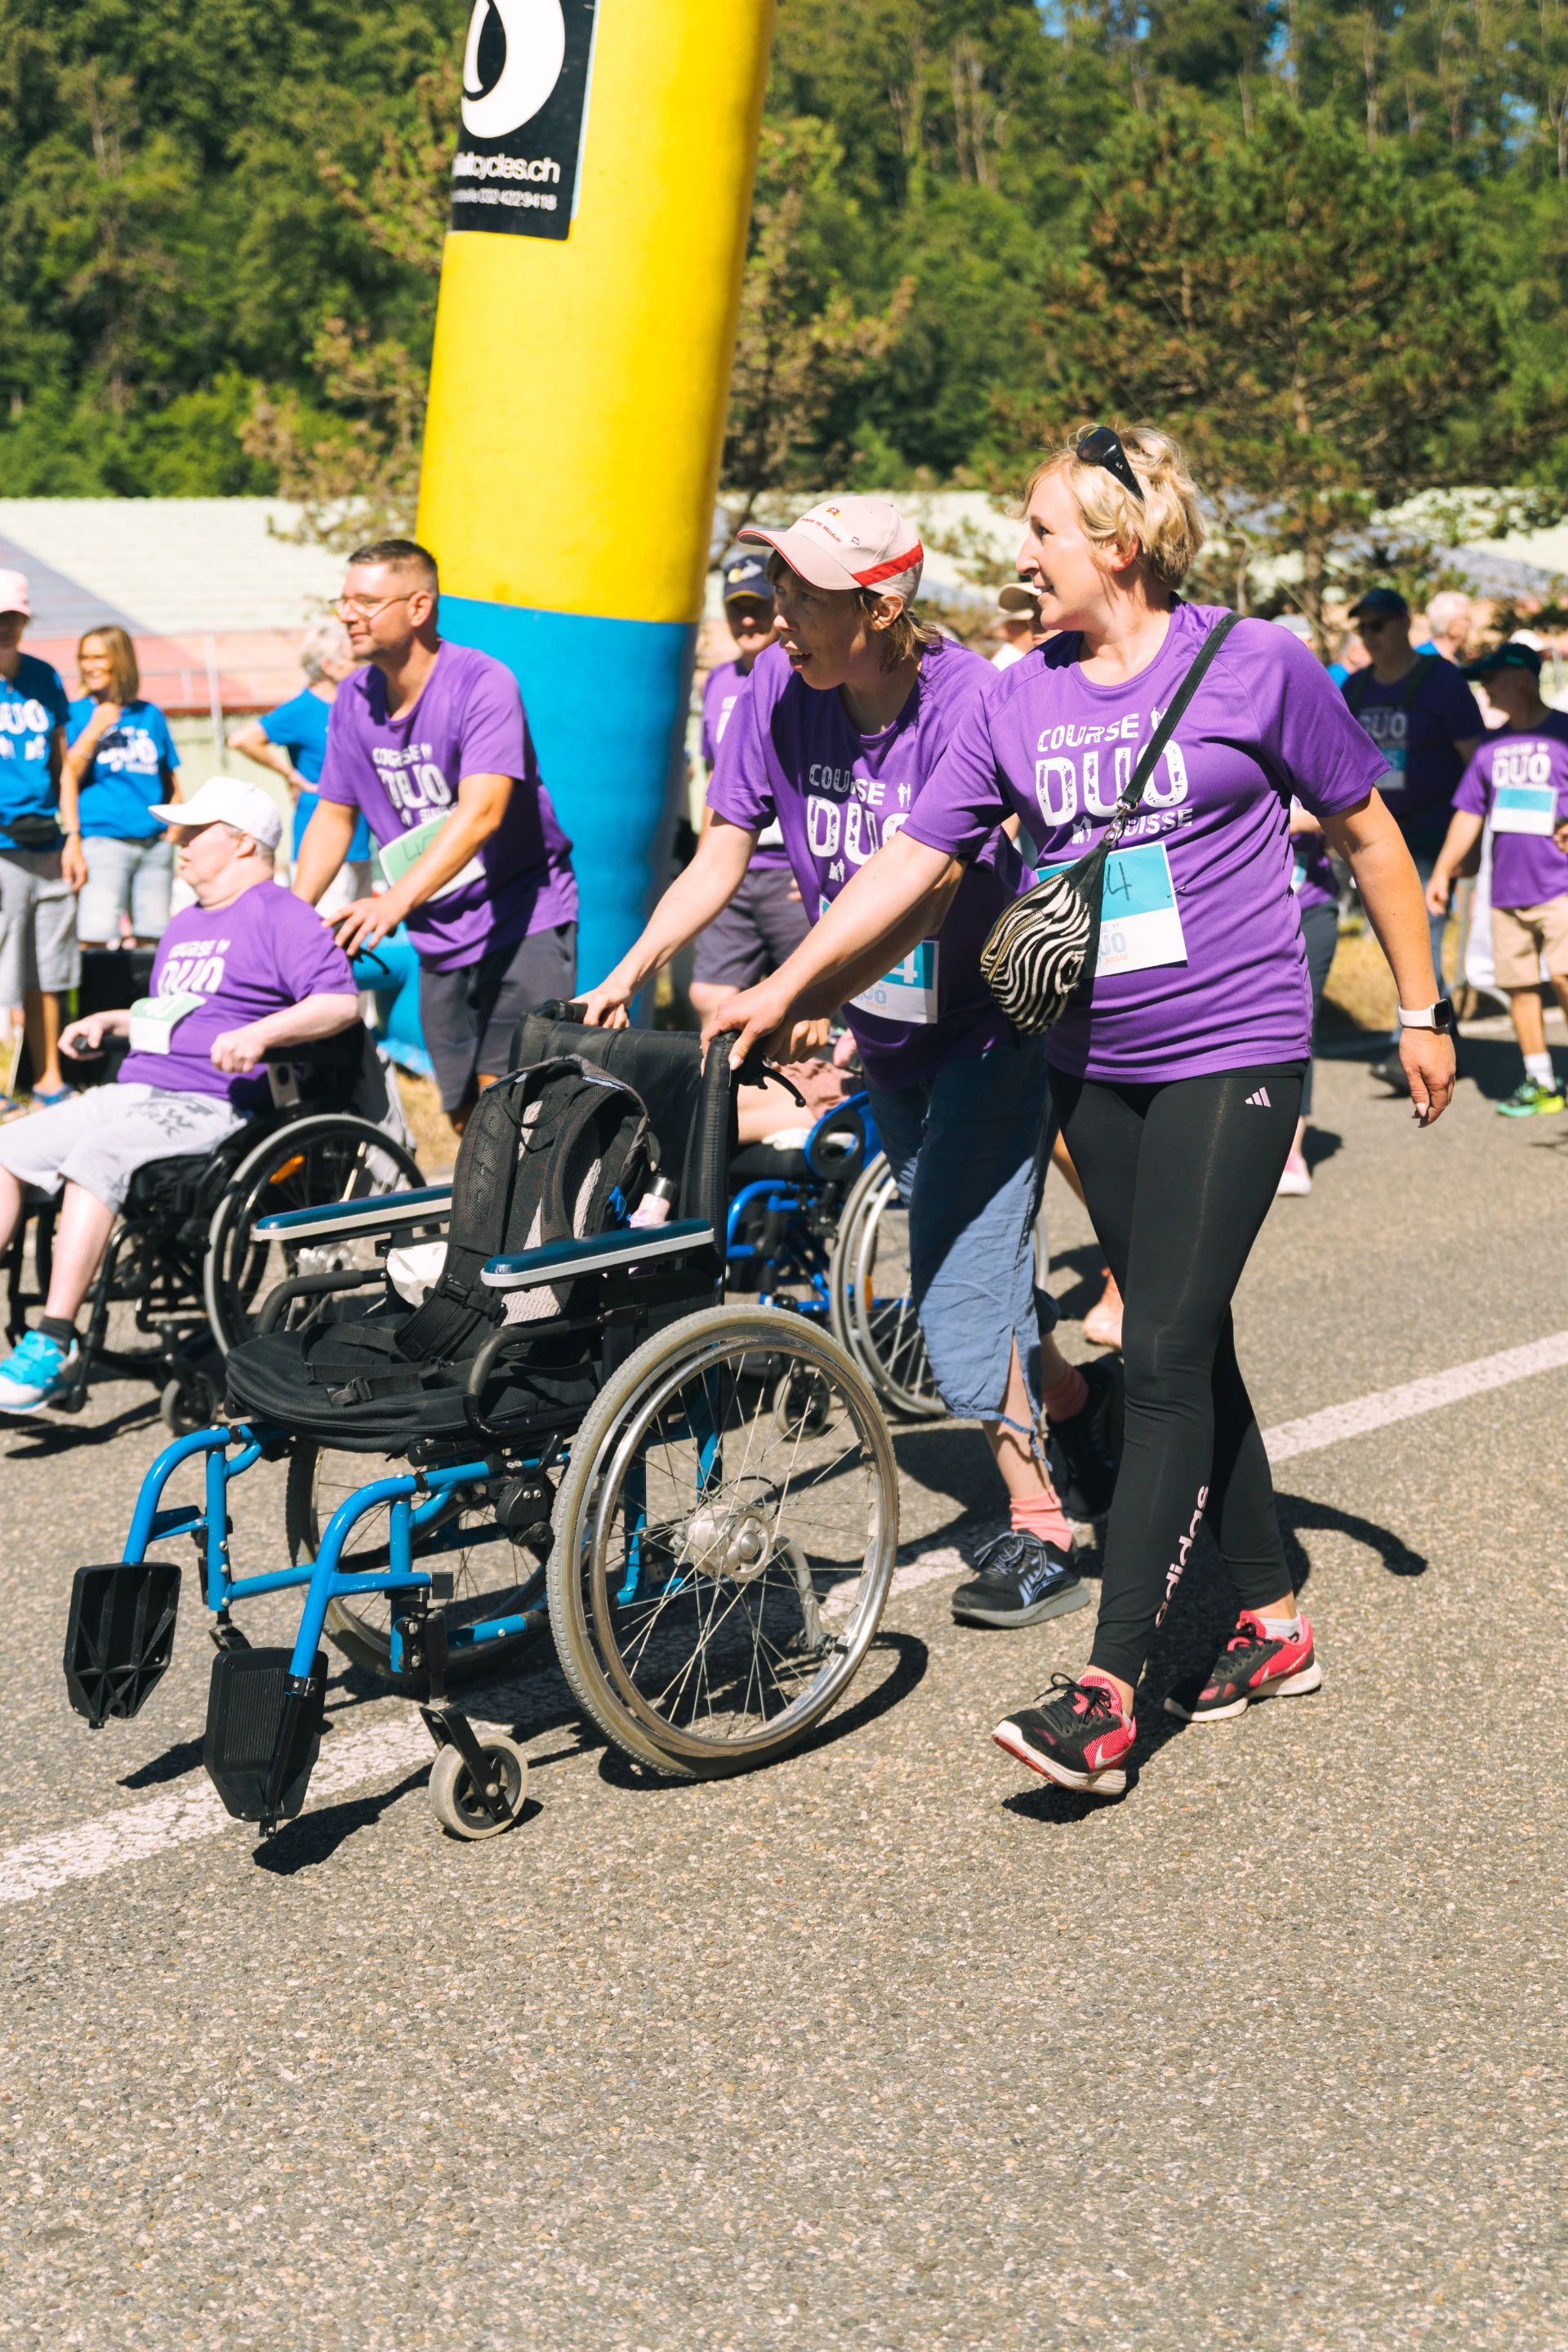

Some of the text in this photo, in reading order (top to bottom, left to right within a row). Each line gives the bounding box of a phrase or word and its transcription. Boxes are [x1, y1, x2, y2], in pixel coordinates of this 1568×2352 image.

[1037, 713, 1139, 752] COURSE
[1035, 739, 1189, 826] DUO
[1491, 752, 1552, 788] DUO
[157, 956, 225, 997] DUO
[1104, 954, 1129, 964] SUISSE
[1155, 1485, 1209, 1628] adidas
